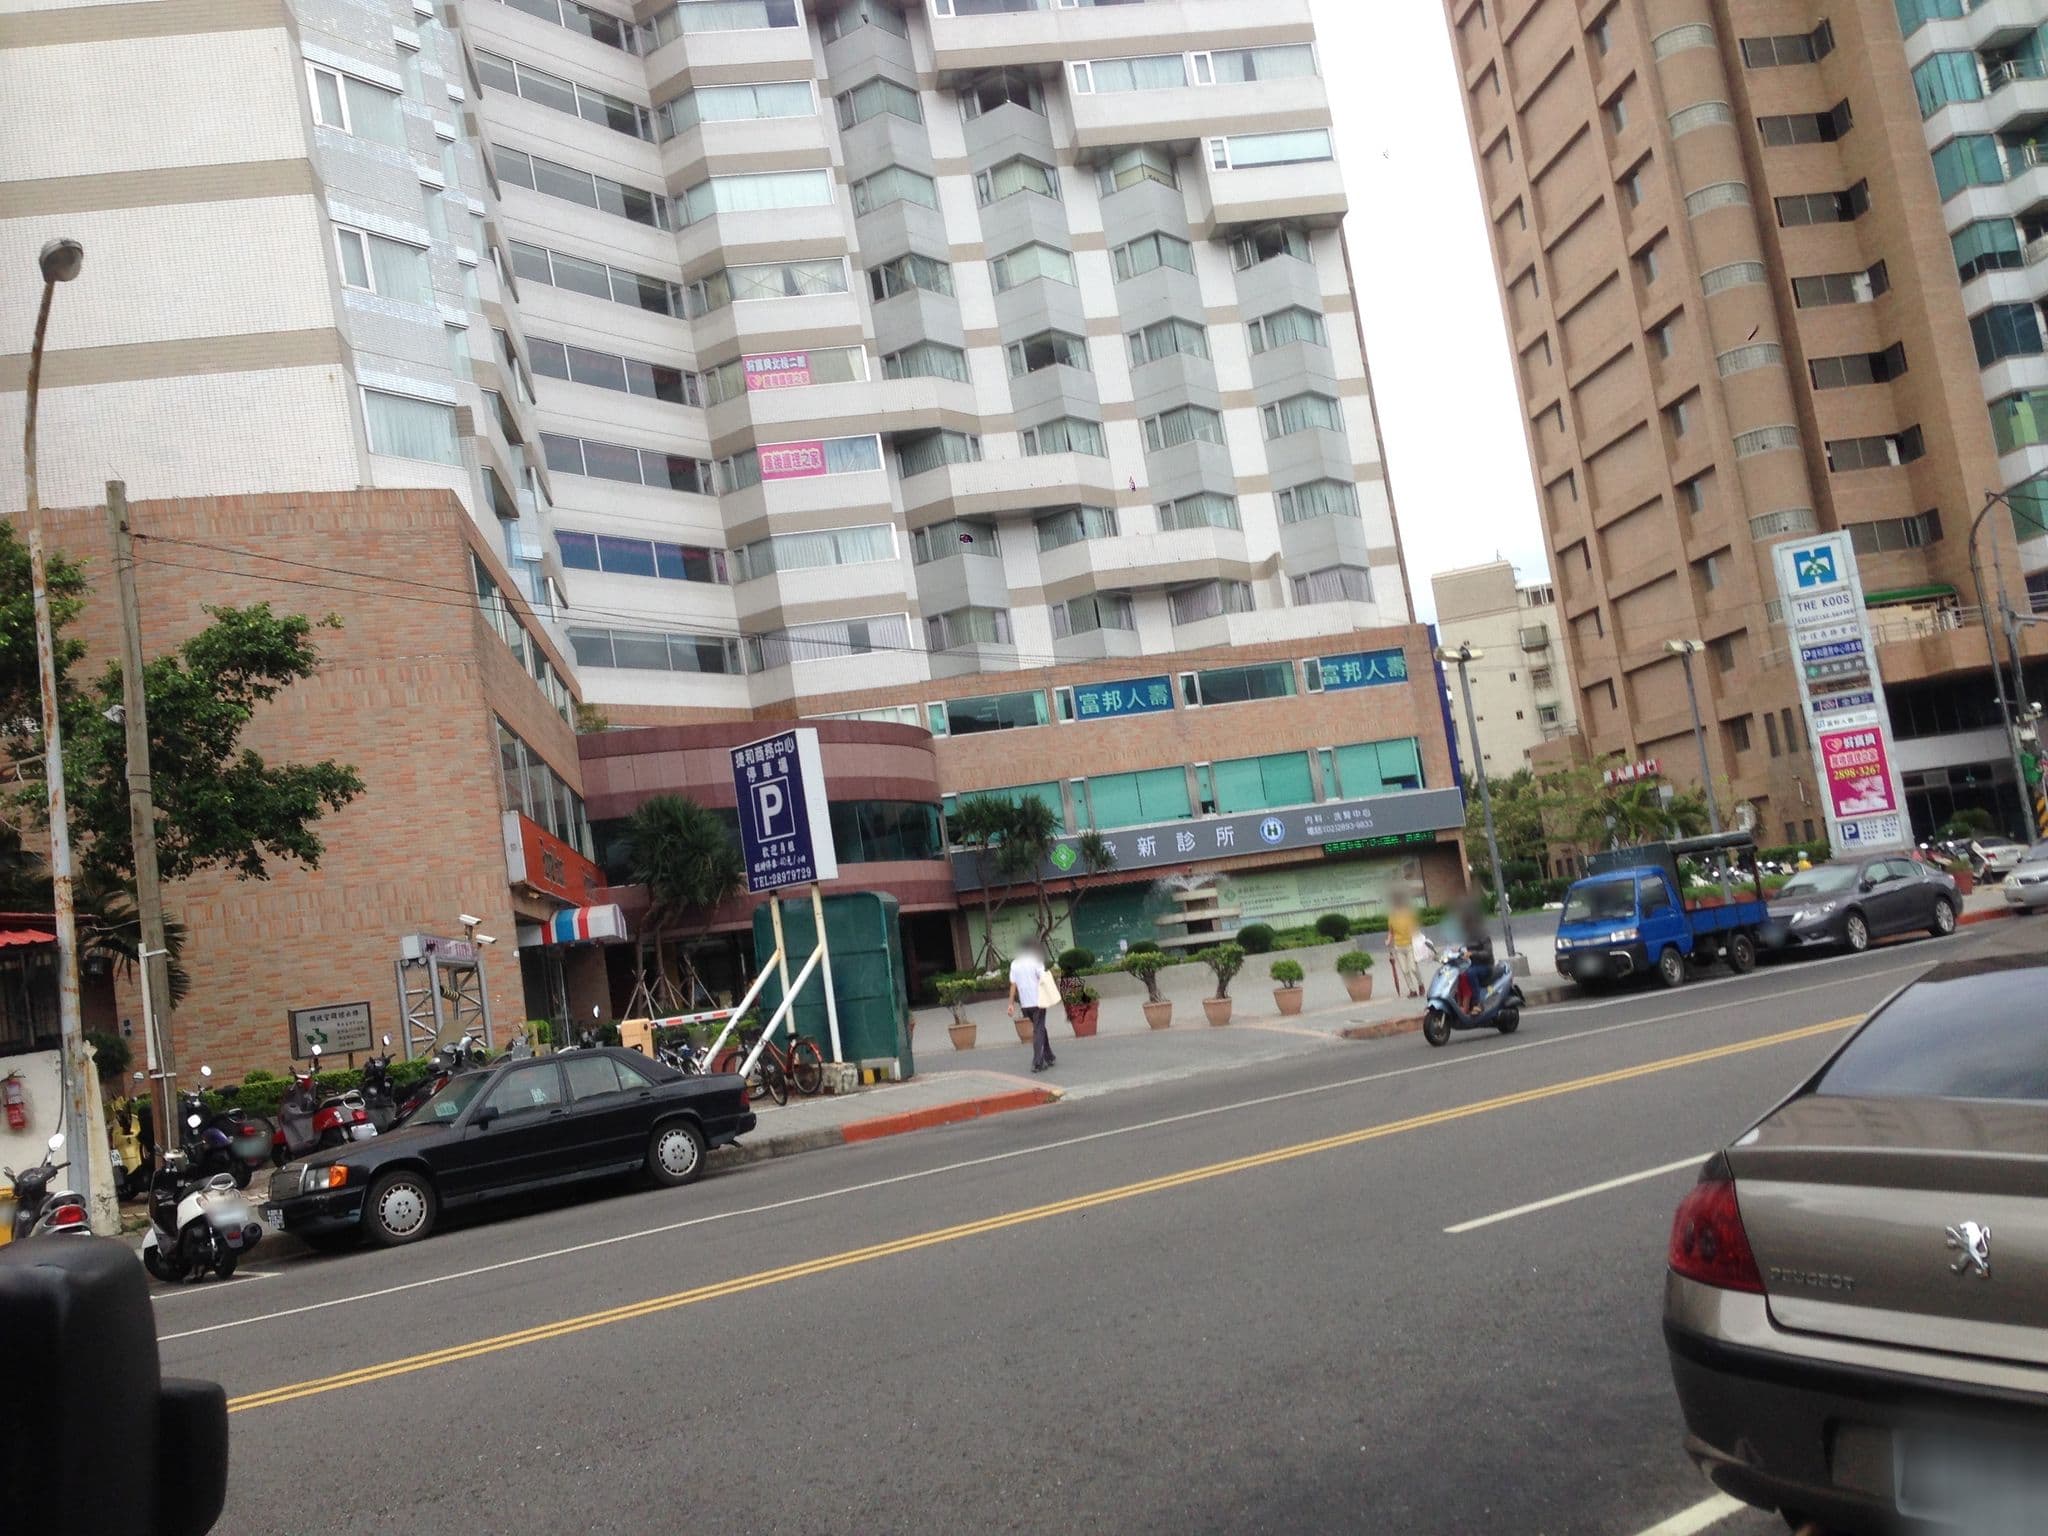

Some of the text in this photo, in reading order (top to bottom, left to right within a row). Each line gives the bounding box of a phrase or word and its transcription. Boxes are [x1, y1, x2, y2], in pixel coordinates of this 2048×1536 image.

[762, 448, 822, 473] 產後護理之家
[1797, 594, 1850, 612] THE KOOS
[1320, 655, 1407, 685] 富邦人壽
[1078, 684, 1168, 715] 富邦人壽
[735, 736, 795, 769] 捷和商務中心
[746, 756, 789, 783] 停車場
[758, 783, 784, 837] P
[1843, 824, 1858, 839] P
[1769, 1267, 1856, 1290] PEUGEOT
